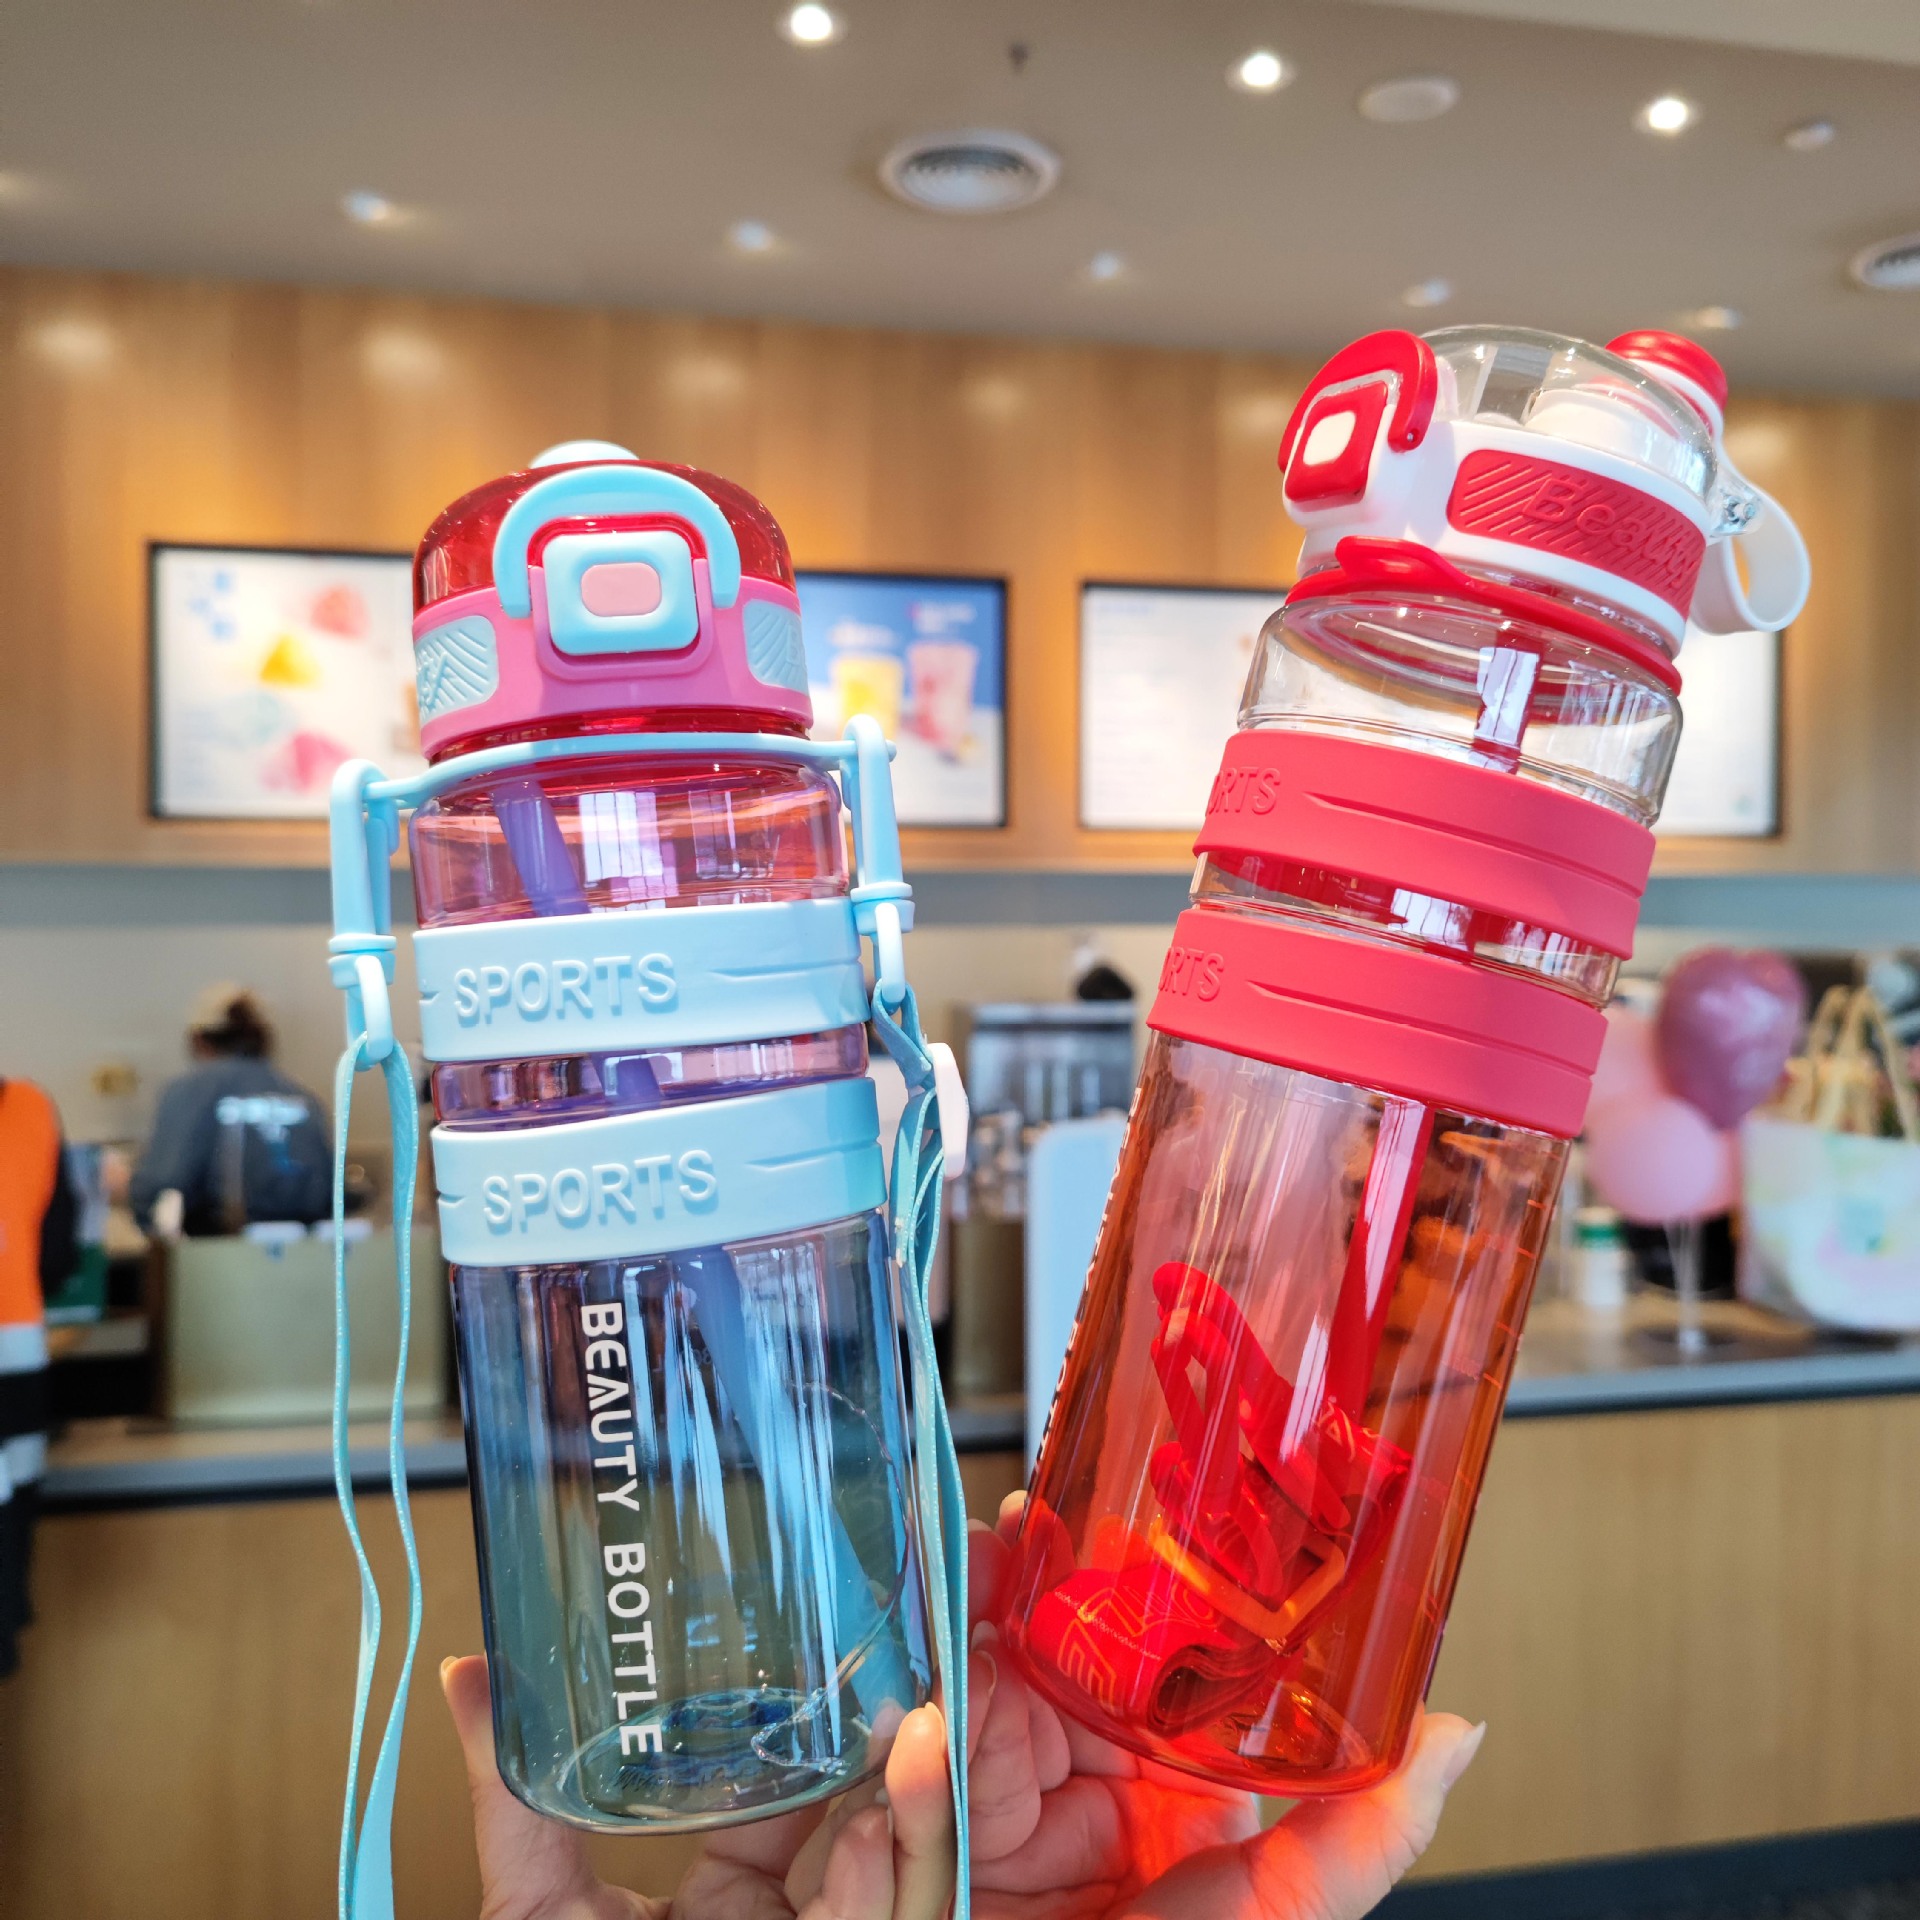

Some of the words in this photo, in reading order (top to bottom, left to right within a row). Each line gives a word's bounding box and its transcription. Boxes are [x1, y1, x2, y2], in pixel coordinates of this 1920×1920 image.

[453, 952, 677, 1023] SPORTS
[483, 1149, 717, 1231] SPORTS
[581, 1301, 641, 1512] BEAUTY
[604, 1542, 664, 1756] BOTTLE
